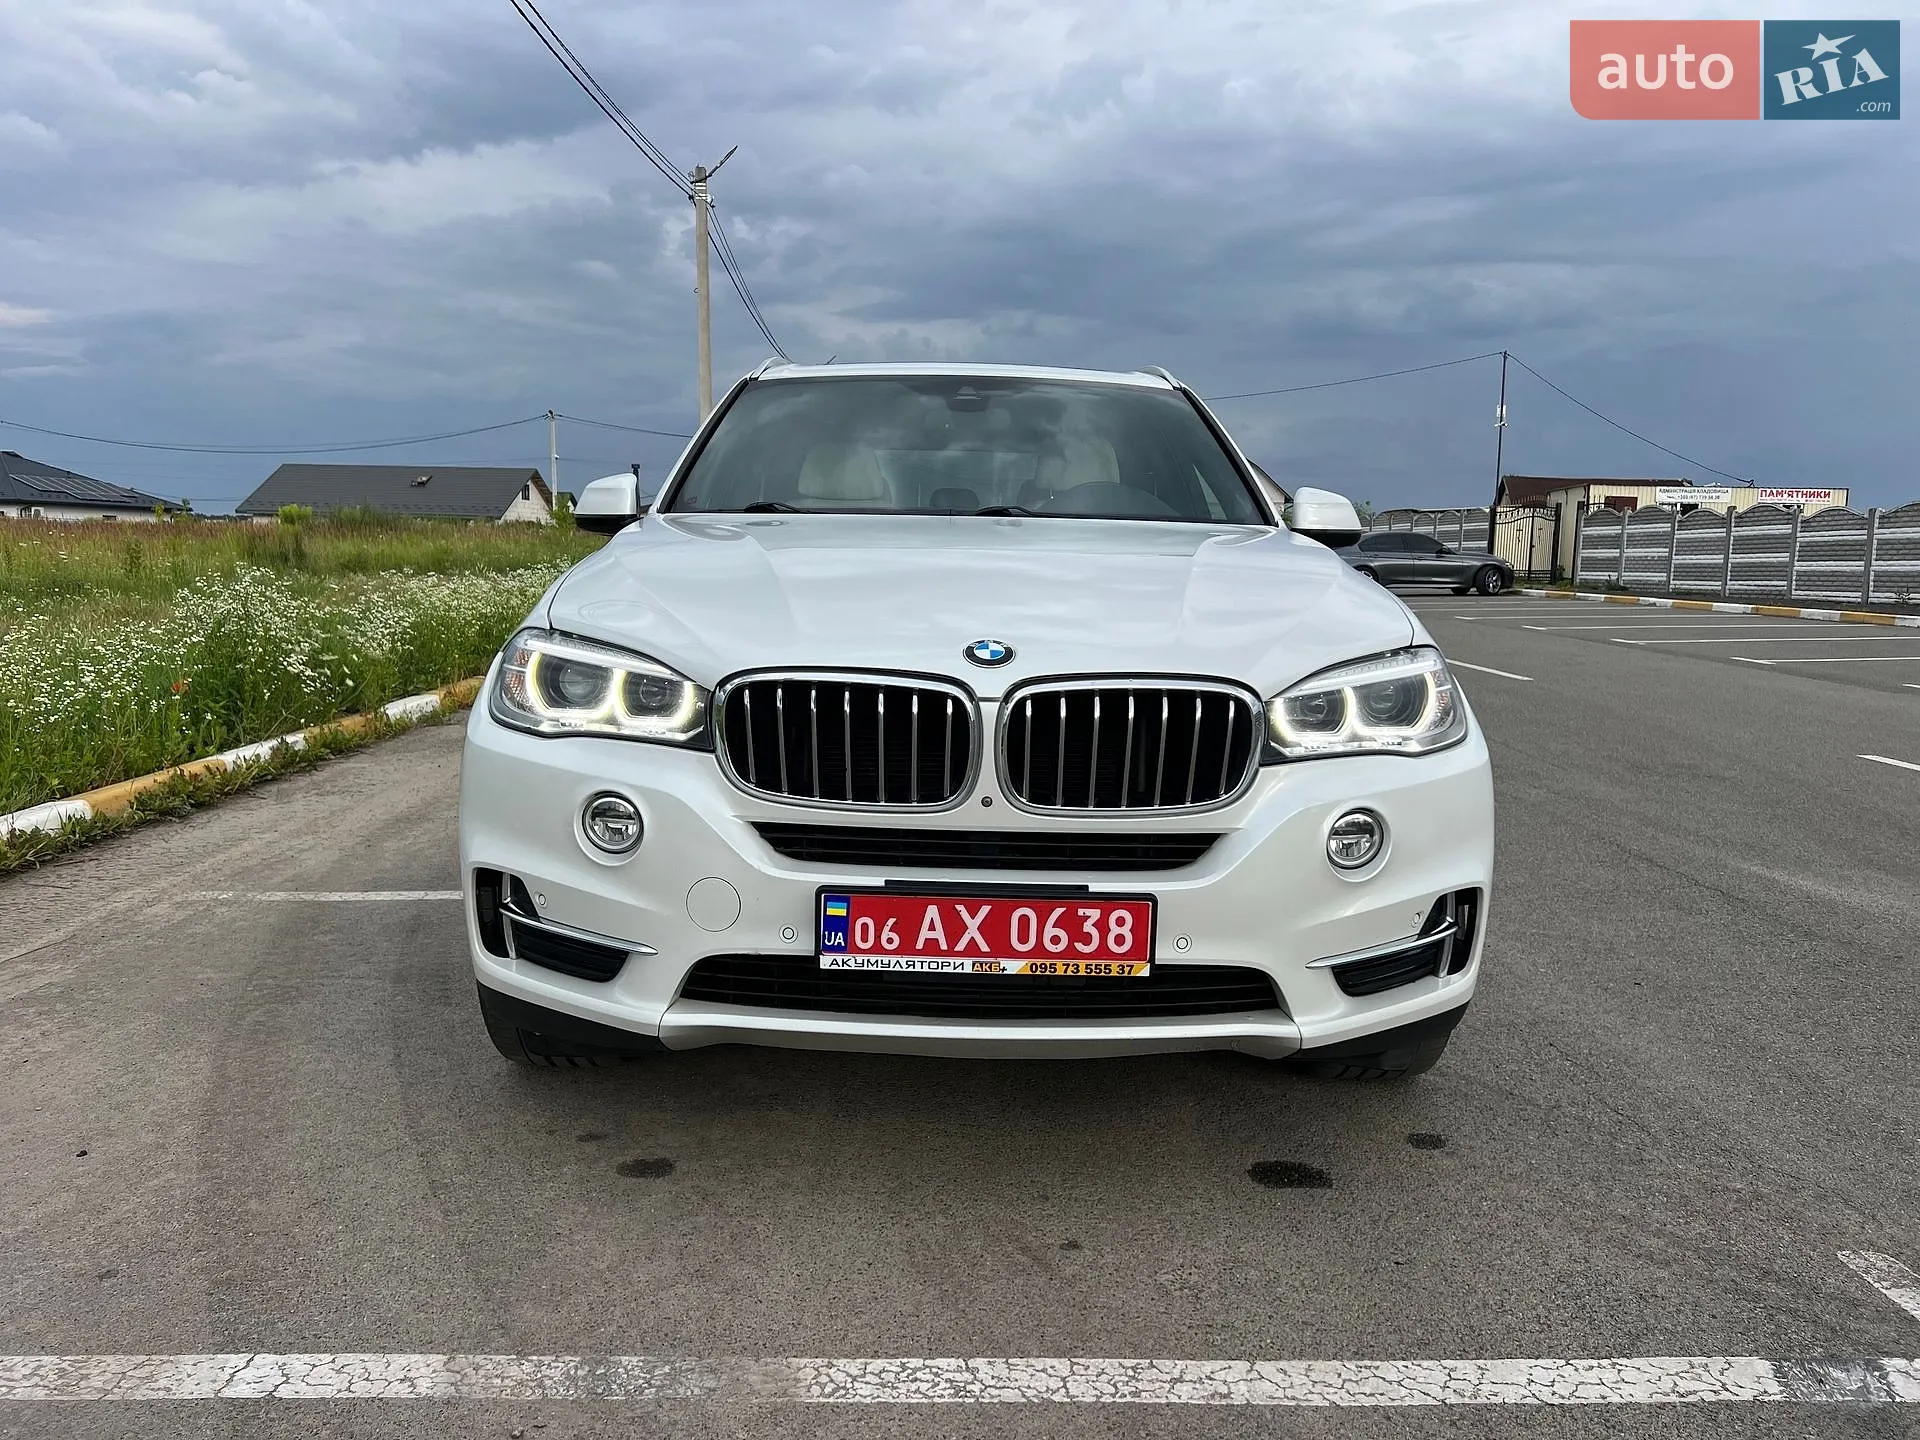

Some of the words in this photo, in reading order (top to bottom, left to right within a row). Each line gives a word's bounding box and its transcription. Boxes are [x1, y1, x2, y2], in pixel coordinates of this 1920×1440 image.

[1760, 489, 1831, 499] ПАМ'ЯТНИКИ
[854, 916, 900, 951] 06
[915, 904, 992, 952] AX
[1010, 906, 1133, 954] 0638
[824, 931, 845, 947] UA
[828, 958, 965, 971] АКУМУЛЯТОРИ
[1029, 962, 1058, 974] 095
[1062, 963, 1081, 975] 73
[1084, 963, 1113, 975] 555
[1116, 964, 1135, 975] 37
